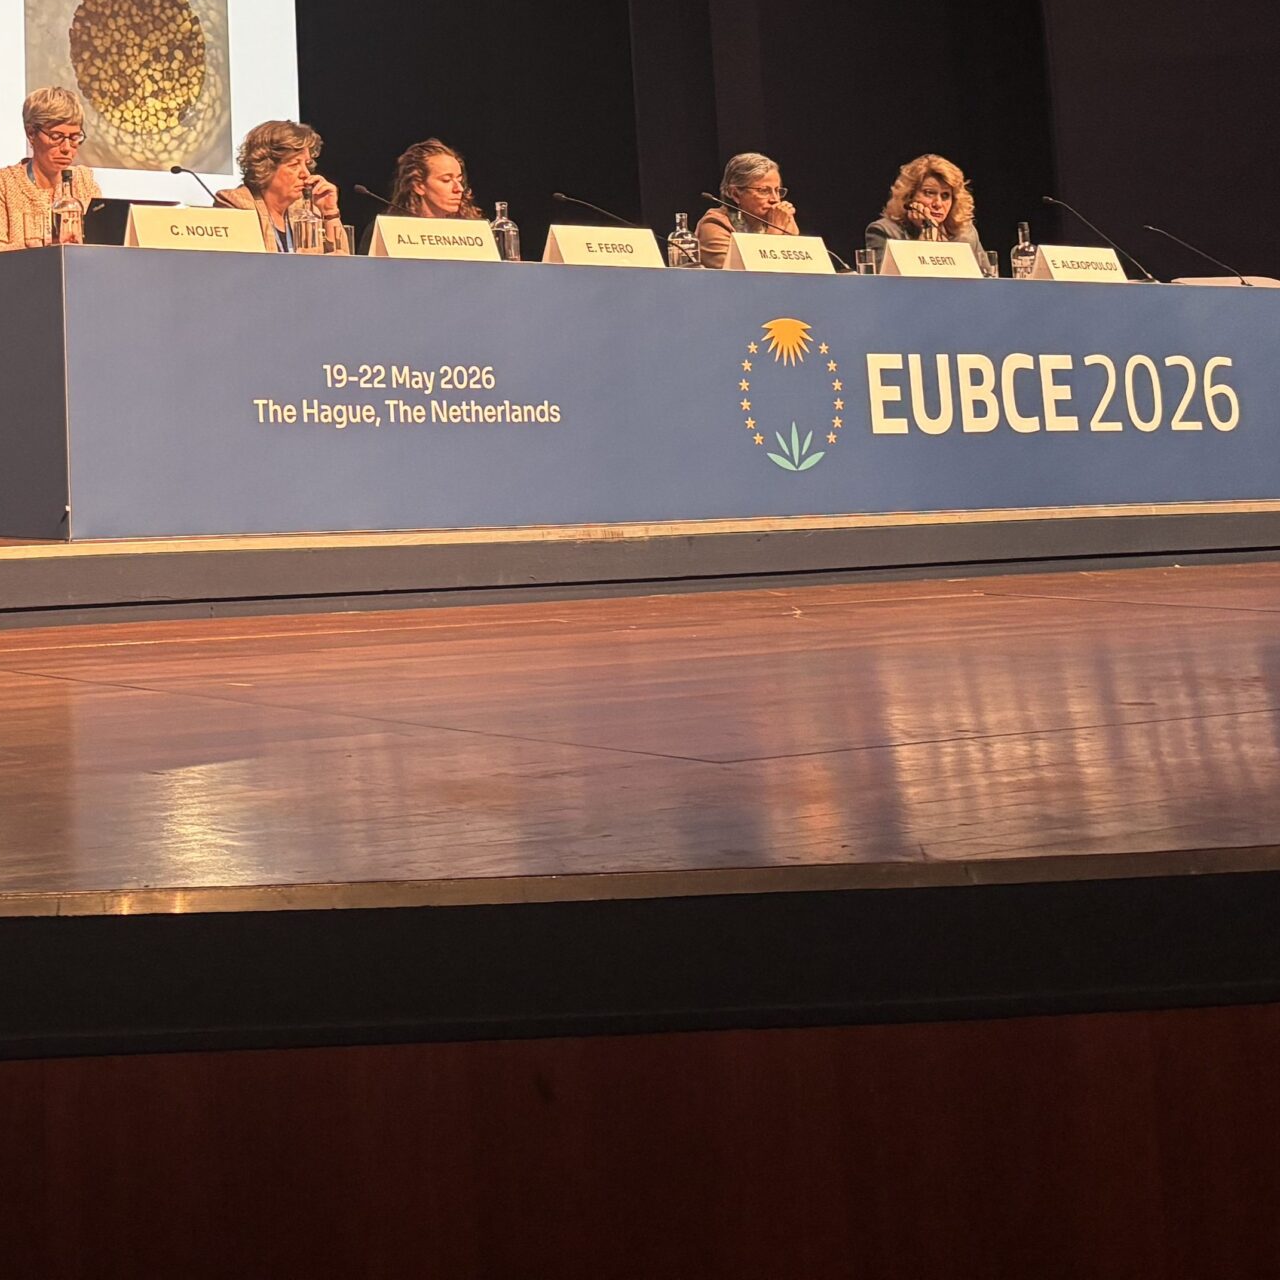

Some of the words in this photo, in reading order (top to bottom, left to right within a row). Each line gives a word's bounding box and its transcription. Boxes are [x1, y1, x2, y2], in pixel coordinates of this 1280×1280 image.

[170, 224, 183, 237] C.
[185, 224, 230, 238] NOUET
[397, 233, 418, 246] A.L.
[420, 234, 484, 248] FERNANDO
[585, 242, 596, 253] E.
[598, 243, 634, 254] FERRO
[758, 249, 779, 261] M.G.
[781, 250, 813, 261] SESSA
[918, 255, 929, 266] M.
[931, 256, 956, 267] BERTI
[1051, 259, 1060, 269] E.
[1061, 260, 1118, 271] ALEXOPOULOU
[391, 365, 436, 395] May
[439, 365, 496, 390] 2026
[866, 353, 1079, 435] EUBCE
[1084, 353, 1240, 433] 2026
[253, 399, 297, 424] The
[302, 399, 381, 429] Hague,
[384, 400, 427, 424] The
[431, 400, 562, 424] Netherlands
